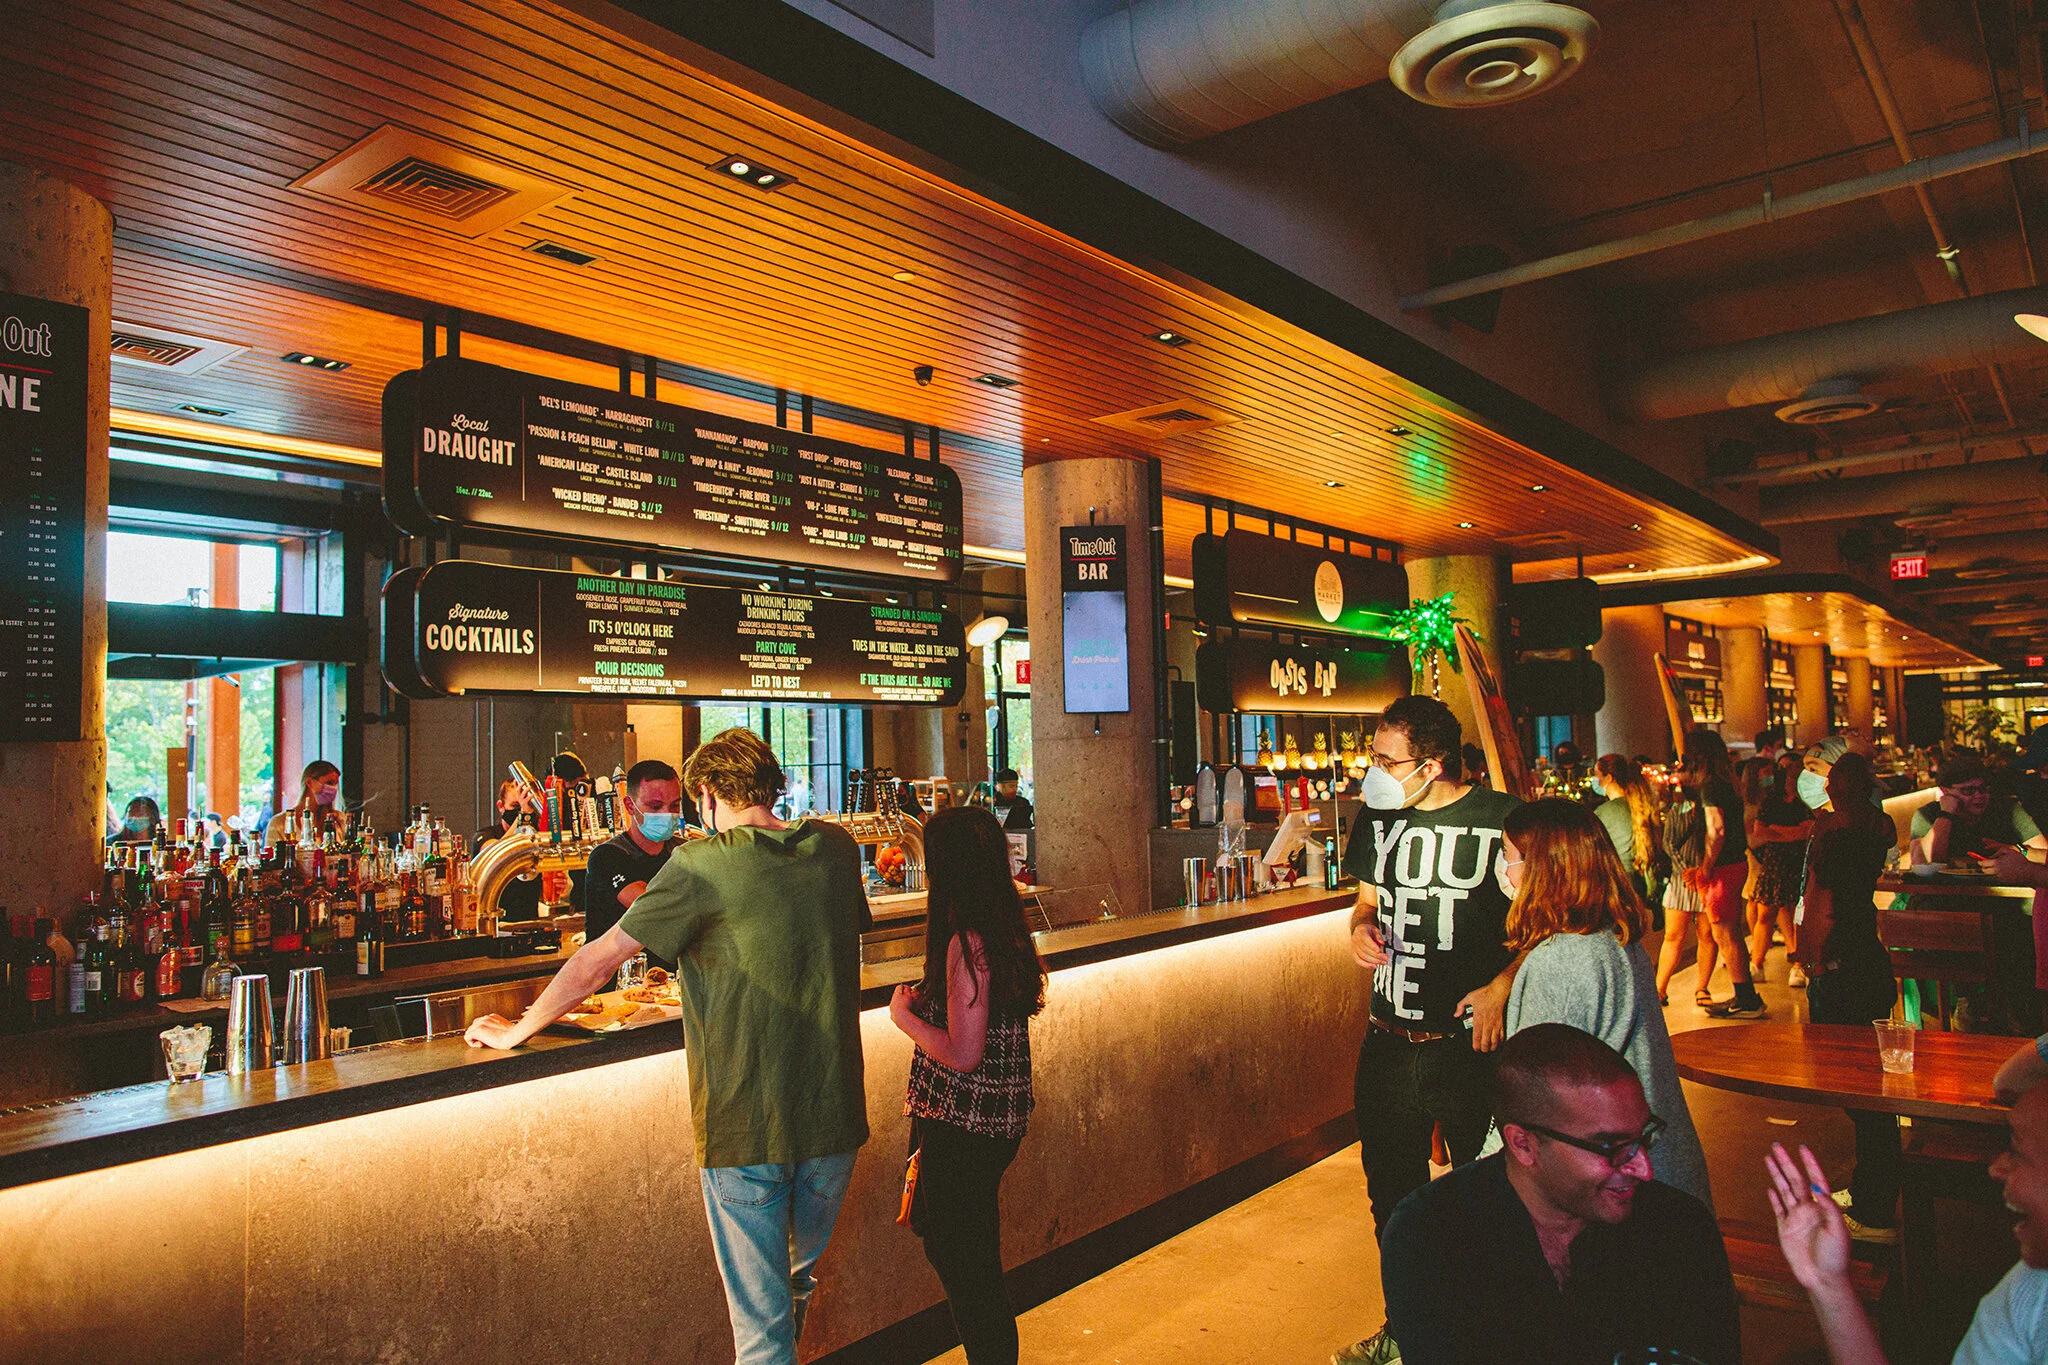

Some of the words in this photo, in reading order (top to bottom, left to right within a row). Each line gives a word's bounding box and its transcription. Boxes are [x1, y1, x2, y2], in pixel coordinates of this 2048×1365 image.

[4, 316, 52, 357] Out
[451, 413, 489, 433] Local
[561, 400, 599, 417] LEMONADE'
[605, 409, 653, 428] NARRAGANSETT
[423, 426, 516, 466] DRAUGHT
[527, 424, 560, 441] 'PASSION
[561, 431, 567, 441] &
[568, 431, 590, 445] PEACH
[591, 436, 618, 450] BELLINI'
[623, 442, 644, 455] WHITE
[645, 446, 660, 458] LION
[678, 452, 685, 463] 13
[782, 446, 789, 456] 12
[537, 454, 575, 471] 'AMERICAN
[576, 461, 600, 475] LAGER'
[606, 466, 629, 480] CASTLE
[630, 470, 653, 484] ISLAND
[657, 475, 662, 485] 8
[671, 477, 677, 488] 11
[705, 457, 717, 468] HOP
[718, 459, 723, 470] &
[776, 471, 780, 480] 9
[787, 473, 793, 483] 12
[478, 488, 494, 499] 22oz.
[740, 489, 753, 500] FORE
[813, 478, 816, 486] A
[858, 486, 862, 494] A
[552, 487, 581, 502] 'WICKED
[582, 492, 607, 508] BUENO'
[613, 497, 638, 511] BANDED
[641, 501, 646, 511] 9
[655, 503, 662, 514] 12
[771, 521, 775, 530] 9
[782, 522, 789, 532] 12
[849, 533, 853, 542] 9
[860, 534, 866, 544] 12
[1070, 538, 1096, 556] Time
[1096, 537, 1116, 556] Out
[1078, 563, 1108, 581] BAR
[1898, 559, 1923, 578] EXIT
[576, 593, 604, 602] GOOSENECK
[577, 578, 616, 593] ANOTHER
[619, 582, 635, 595] DAY
[637, 584, 645, 596] IN
[648, 585, 686, 600] PARADISE
[602, 602, 618, 611] LEMON
[741, 593, 752, 606] NO
[754, 595, 786, 609] WORKING
[788, 598, 813, 611] DURING
[448, 602, 510, 622] Signature
[747, 607, 780, 621] DRINKING
[782, 610, 805, 622] HOURS
[871, 606, 901, 619] STRANDED
[902, 609, 910, 620] ON
[912, 610, 916, 620] A
[917, 611, 942, 623] SANDBAR
[589, 619, 605, 634] IT'S
[607, 620, 613, 635] 5
[614, 621, 651, 637] O'CLOCK
[653, 623, 674, 638] HERE
[425, 623, 534, 655] COCKTAILS
[606, 638, 627, 646] EMPRESS
[756, 641, 778, 654] PARTY
[779, 642, 797, 655] COVE
[610, 645, 634, 654] PINEAPPLE,
[852, 640, 868, 652] TOES
[869, 641, 876, 652] IN
[876, 641, 888, 653] THE
[914, 644, 926, 655] ASS
[927, 645, 932, 656] IN
[933, 645, 944, 656] THE
[944, 646, 959, 657] SAND
[595, 661, 619, 675] POUR
[621, 662, 664, 677] DECISIONS
[1270, 658, 1308, 696] OASIS
[1314, 660, 1337, 697] BAR
[771, 675, 782, 688] TO
[783, 676, 800, 689] REST
[860, 673, 867, 685] IF
[867, 673, 879, 685] THE
[880, 674, 896, 686] TIKIS
[896, 675, 908, 686] ARE
[923, 676, 931, 687] SO
[932, 677, 942, 688] ARE
[943, 677, 952, 688] WE
[1371, 819, 1502, 889] YOU
[1376, 886, 1469, 955] GET
